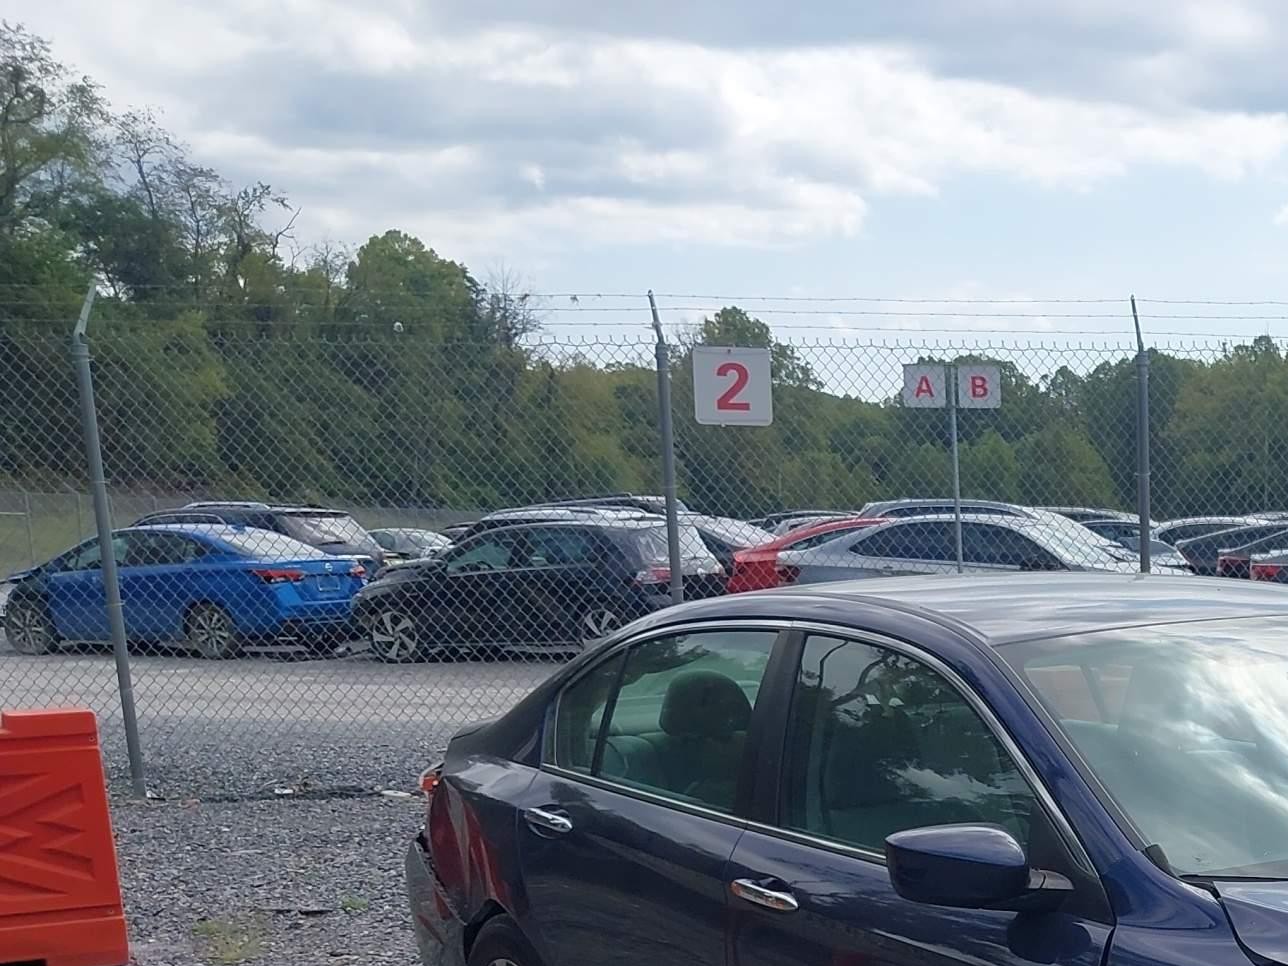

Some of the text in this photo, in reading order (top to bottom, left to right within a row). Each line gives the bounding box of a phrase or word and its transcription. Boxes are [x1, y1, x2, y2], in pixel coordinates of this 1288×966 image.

[715, 361, 751, 412] 2
[915, 375, 935, 399] A
[970, 375, 989, 399] B
